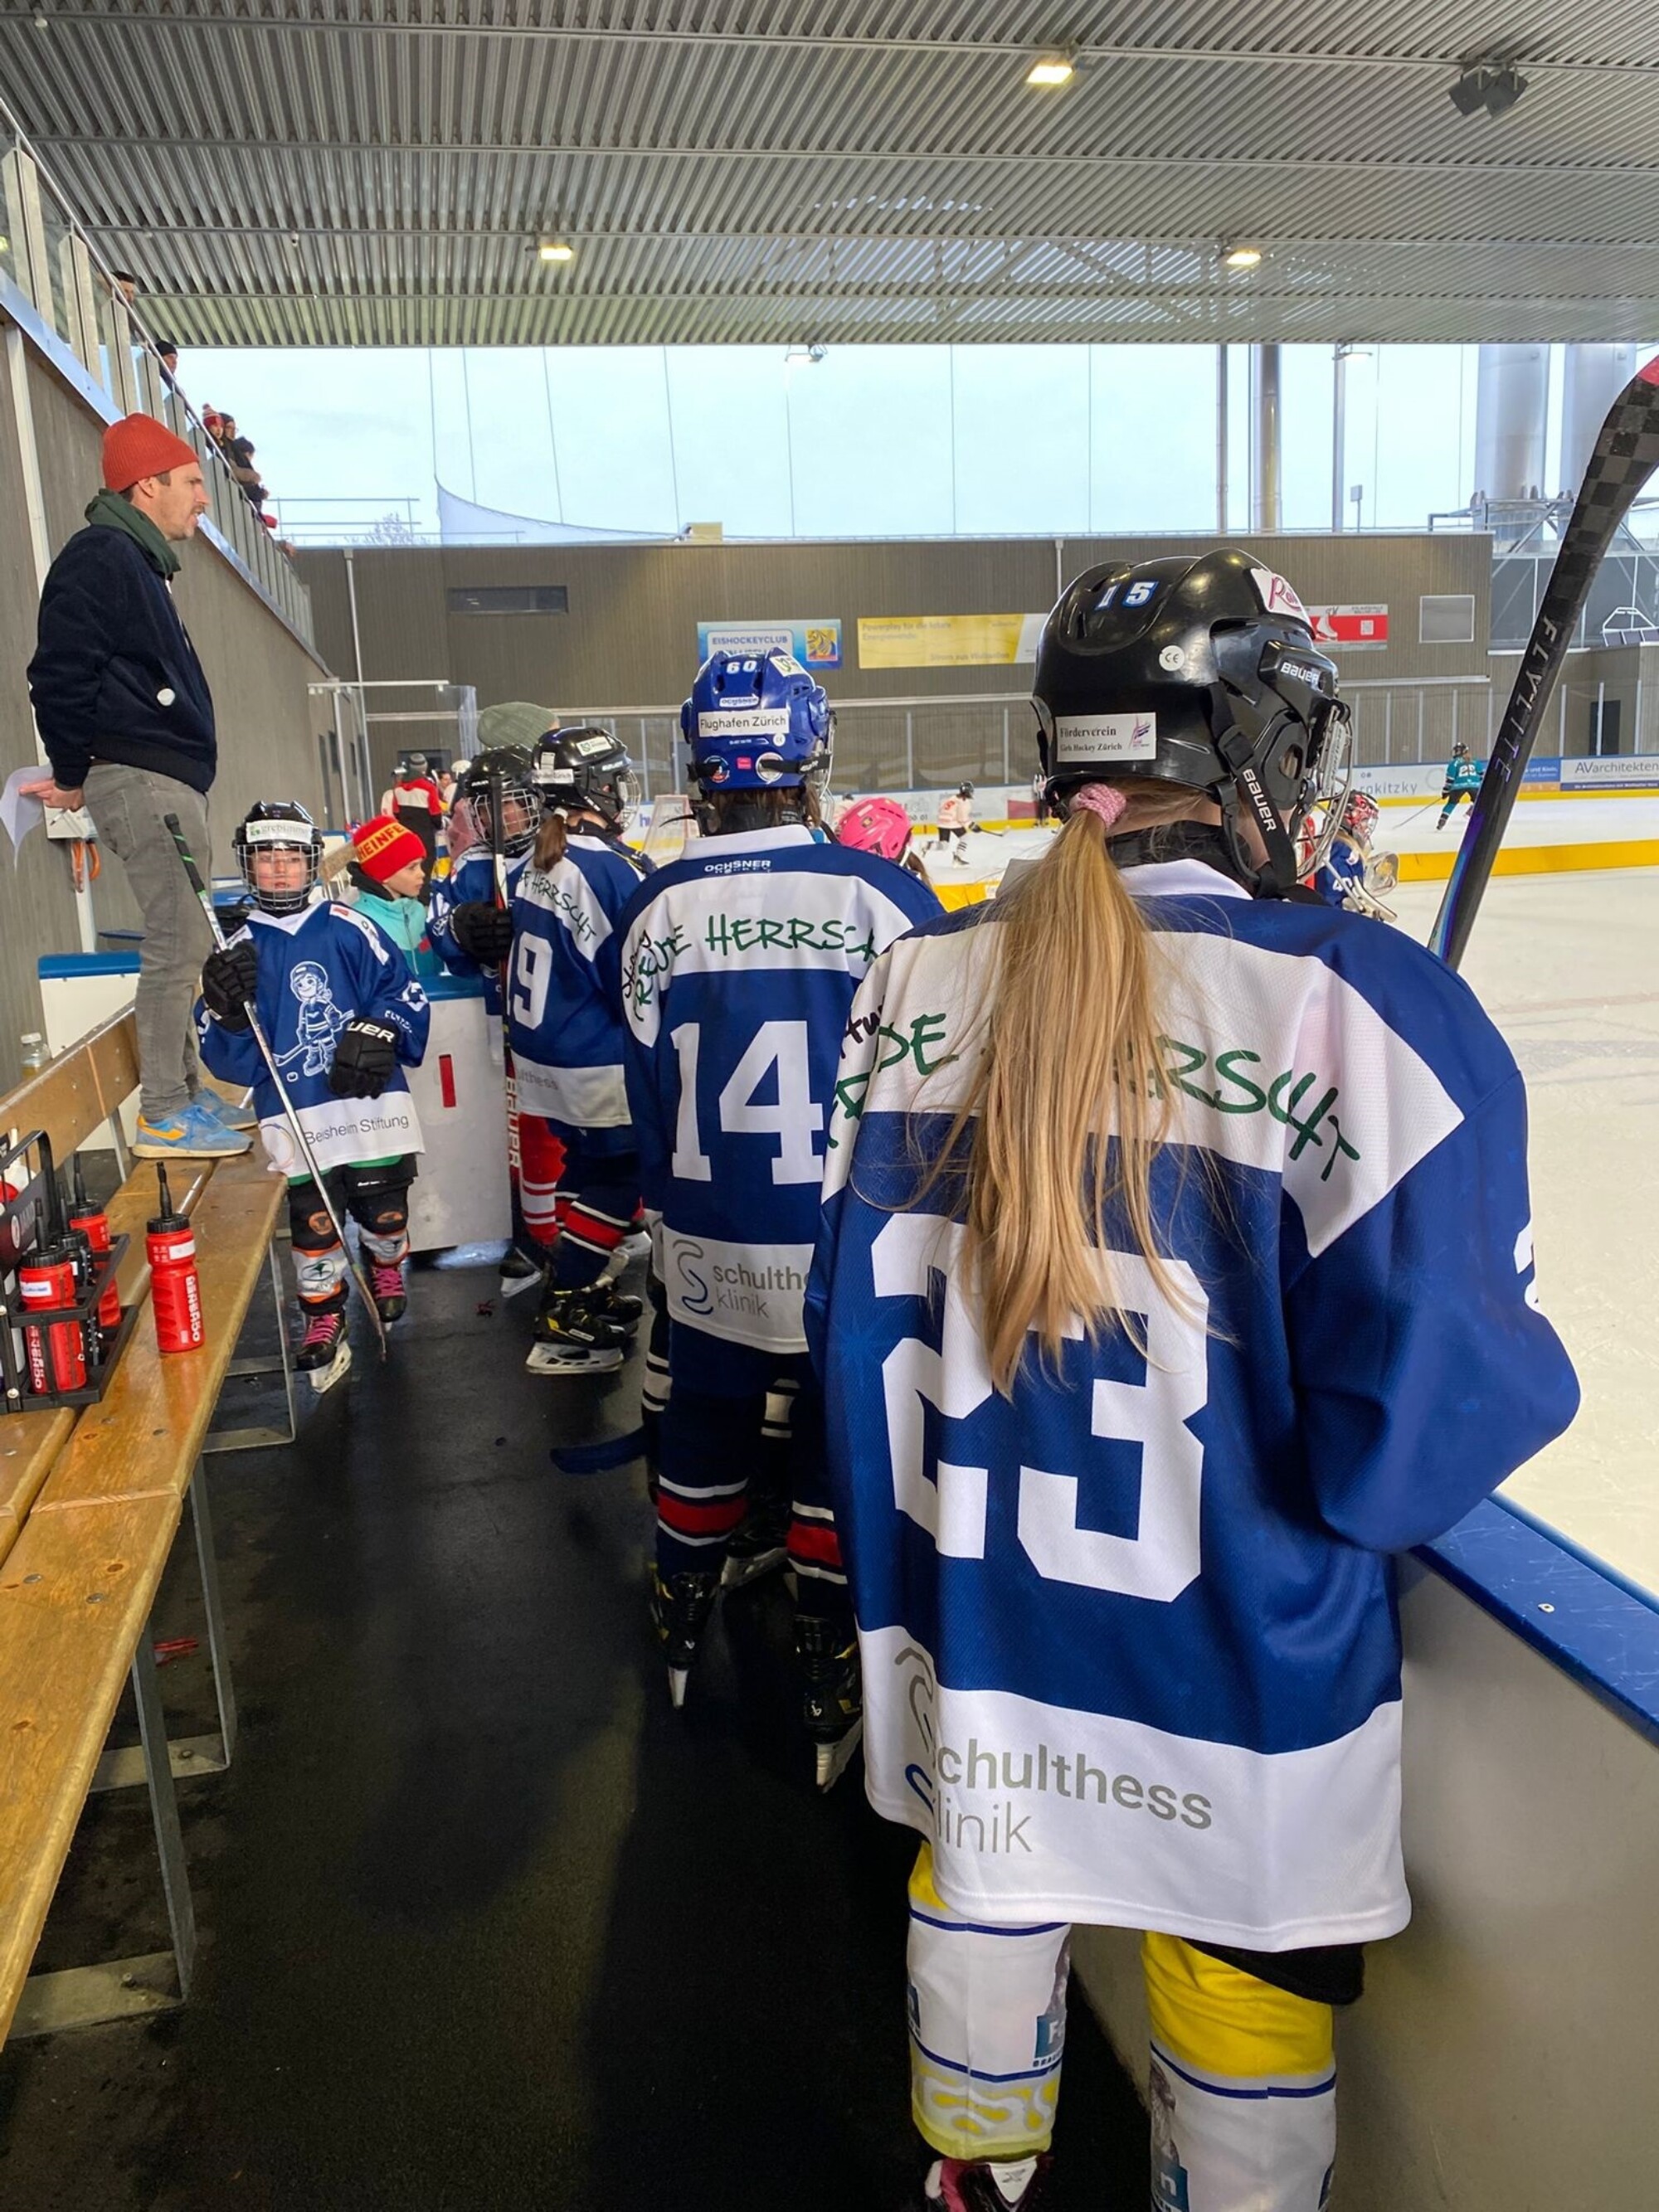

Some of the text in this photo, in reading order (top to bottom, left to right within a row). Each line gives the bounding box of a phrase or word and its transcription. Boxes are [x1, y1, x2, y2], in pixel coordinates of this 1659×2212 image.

[1095, 581, 1159, 610] 15
[712, 636, 787, 644] EISHOCKEYCLUB
[1281, 661, 1320, 685] BAUER
[700, 716, 786, 730] Flughafen Zürich
[1060, 727, 1117, 737] Förderverein
[1097, 742, 1122, 751] Zürich
[1575, 761, 1659, 773] AVarchitekten
[1243, 768, 1277, 832] BAUER
[704, 859, 771, 872] OCHSNER
[670, 1020, 824, 1184] 14
[360, 1115, 409, 1133] Stiftung
[715, 1287, 770, 1319] klinik
[871, 1213, 1209, 1603] 23
[933, 1796, 1033, 1855] linik
